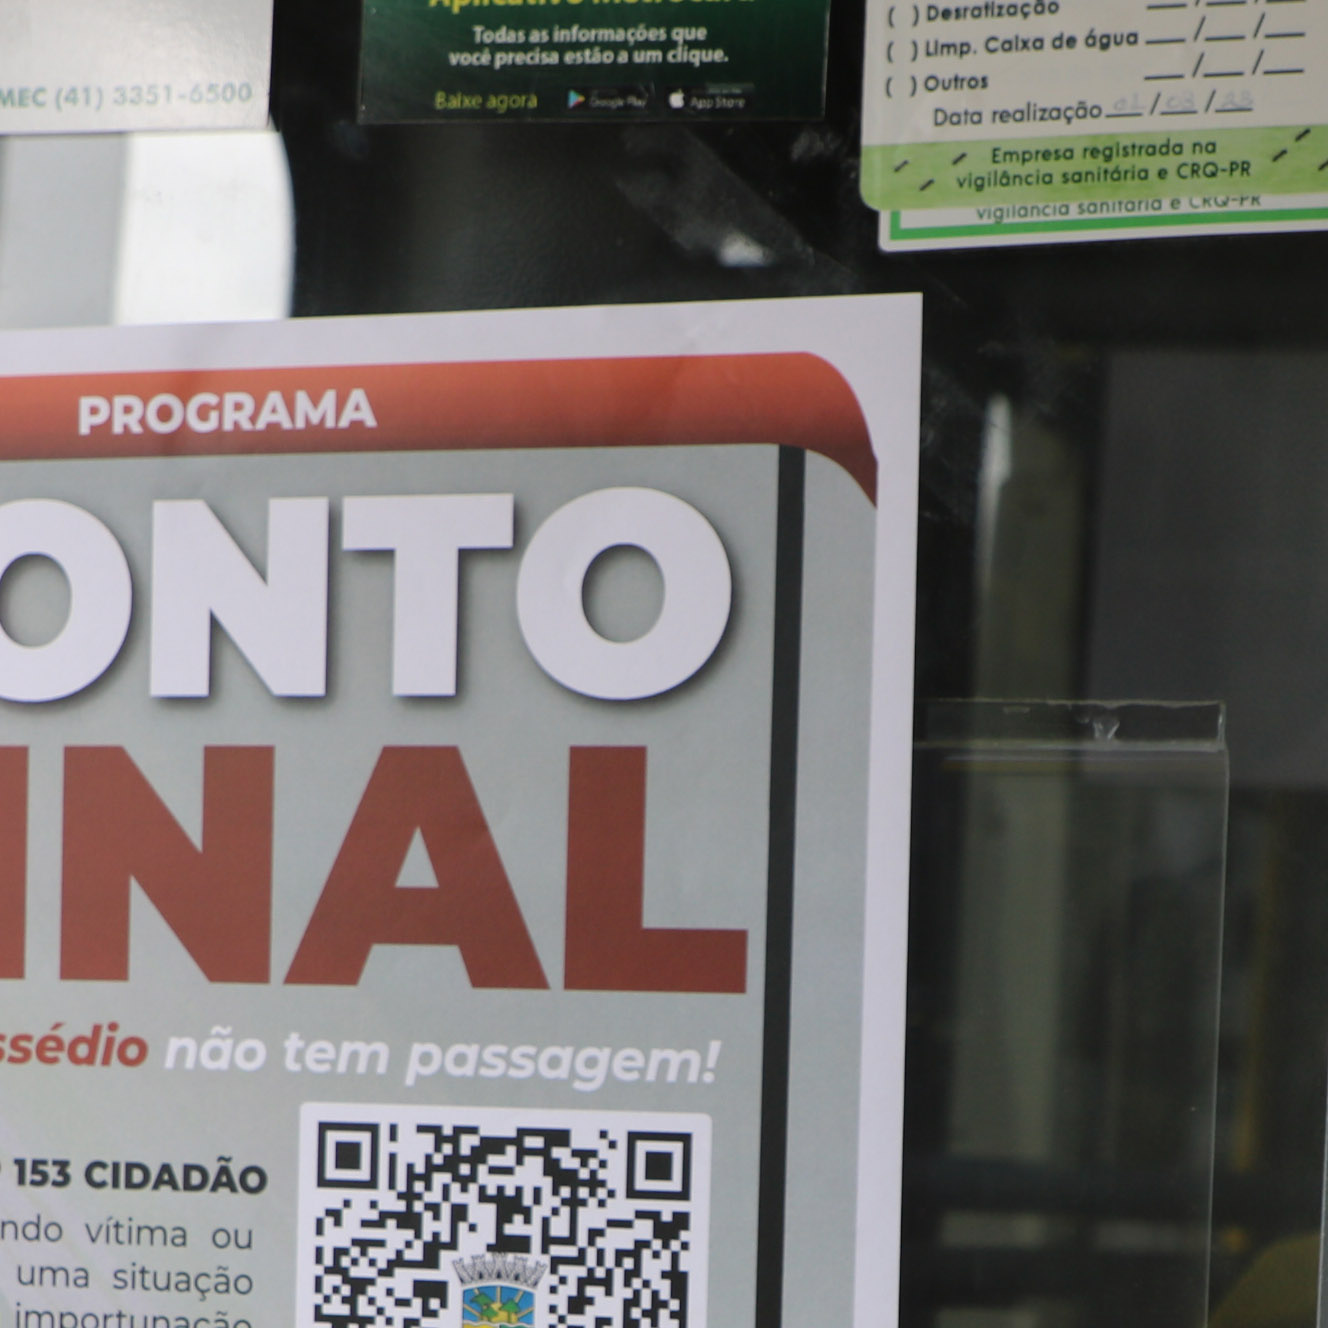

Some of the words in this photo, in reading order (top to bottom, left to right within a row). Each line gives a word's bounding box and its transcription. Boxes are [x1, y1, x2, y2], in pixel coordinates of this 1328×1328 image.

[473, 26, 526, 43] Todas
[529, 29, 549, 42] as
[553, 24, 667, 45] informações
[671, 27, 707, 45] que
[925, 39, 977, 59] Limp.
[984, 35, 1044, 53] Caixa
[1052, 32, 1077, 49] de
[1085, 28, 1139, 51] água
[449, 50, 491, 66] você
[494, 49, 559, 69] precisa
[563, 49, 614, 65] estão
[617, 52, 628, 64] a
[633, 51, 662, 64] um
[666, 47, 729, 68] clique.
[55, 85, 104, 111] (41)
[113, 82, 253, 106] 3351-6500
[924, 75, 988, 92] Outros
[434, 91, 483, 109] Baixe
[486, 93, 538, 113] agora
[934, 108, 982, 127] Data
[992, 101, 1102, 125] realização
[992, 147, 1074, 166] Empresa
[1082, 142, 1183, 162] registrada
[1192, 141, 1216, 155] na
[957, 170, 1053, 191] vigilância
[1062, 164, 1149, 184] sanitária
[1158, 166, 1168, 180] e
[1177, 161, 1251, 180] CRQ-PR
[76, 388, 378, 436] PROGRAMA
[164, 1025, 267, 1073] não
[282, 1032, 390, 1076] tem
[405, 1038, 723, 1094] passagem!
[13, 1158, 72, 1188] 153
[84, 1156, 268, 1195] CIDADÃO
[85, 1216, 187, 1247] vítima
[211, 1225, 253, 1250] ou
[17, 1263, 90, 1289] uma
[112, 1263, 254, 1302] situação
